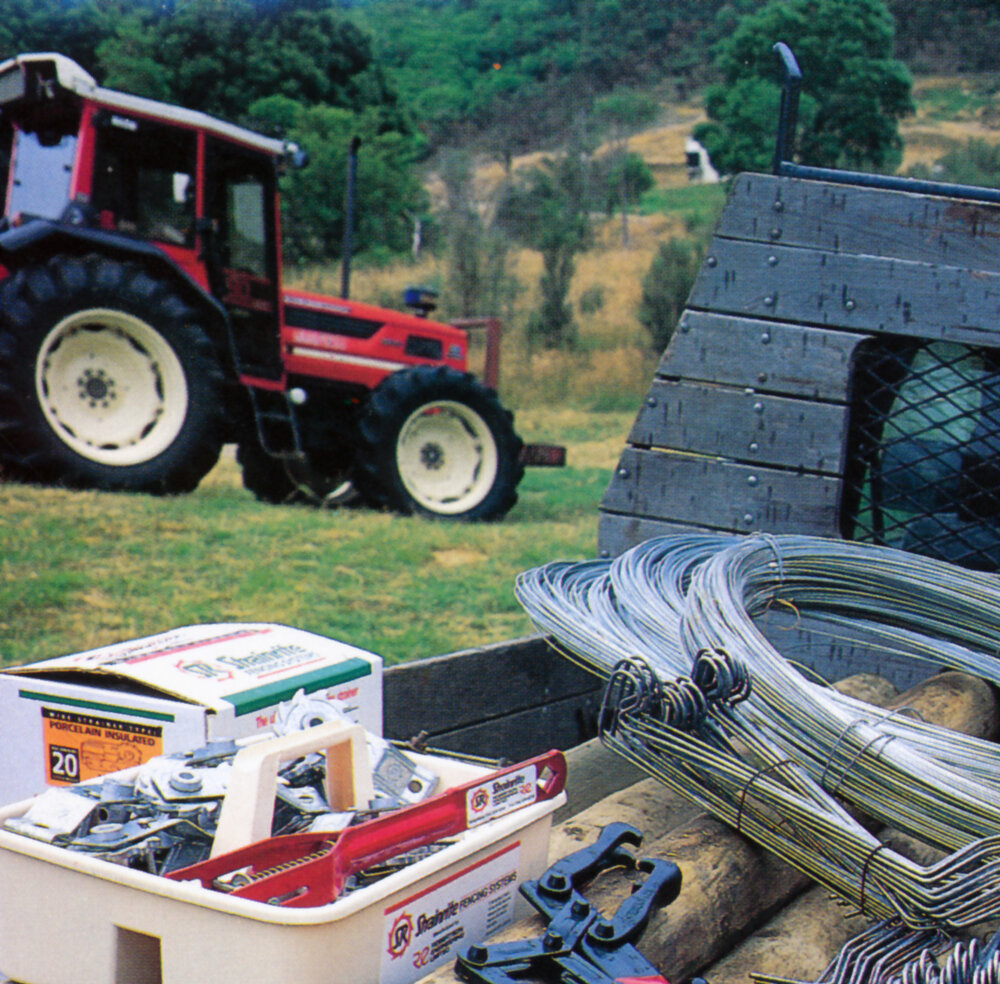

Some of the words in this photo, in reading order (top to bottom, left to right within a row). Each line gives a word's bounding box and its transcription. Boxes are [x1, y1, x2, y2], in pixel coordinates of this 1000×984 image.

[49, 720, 102, 737] PORCELAIN
[104, 729, 156, 747] INSULATED
[52, 750, 78, 778] 20
